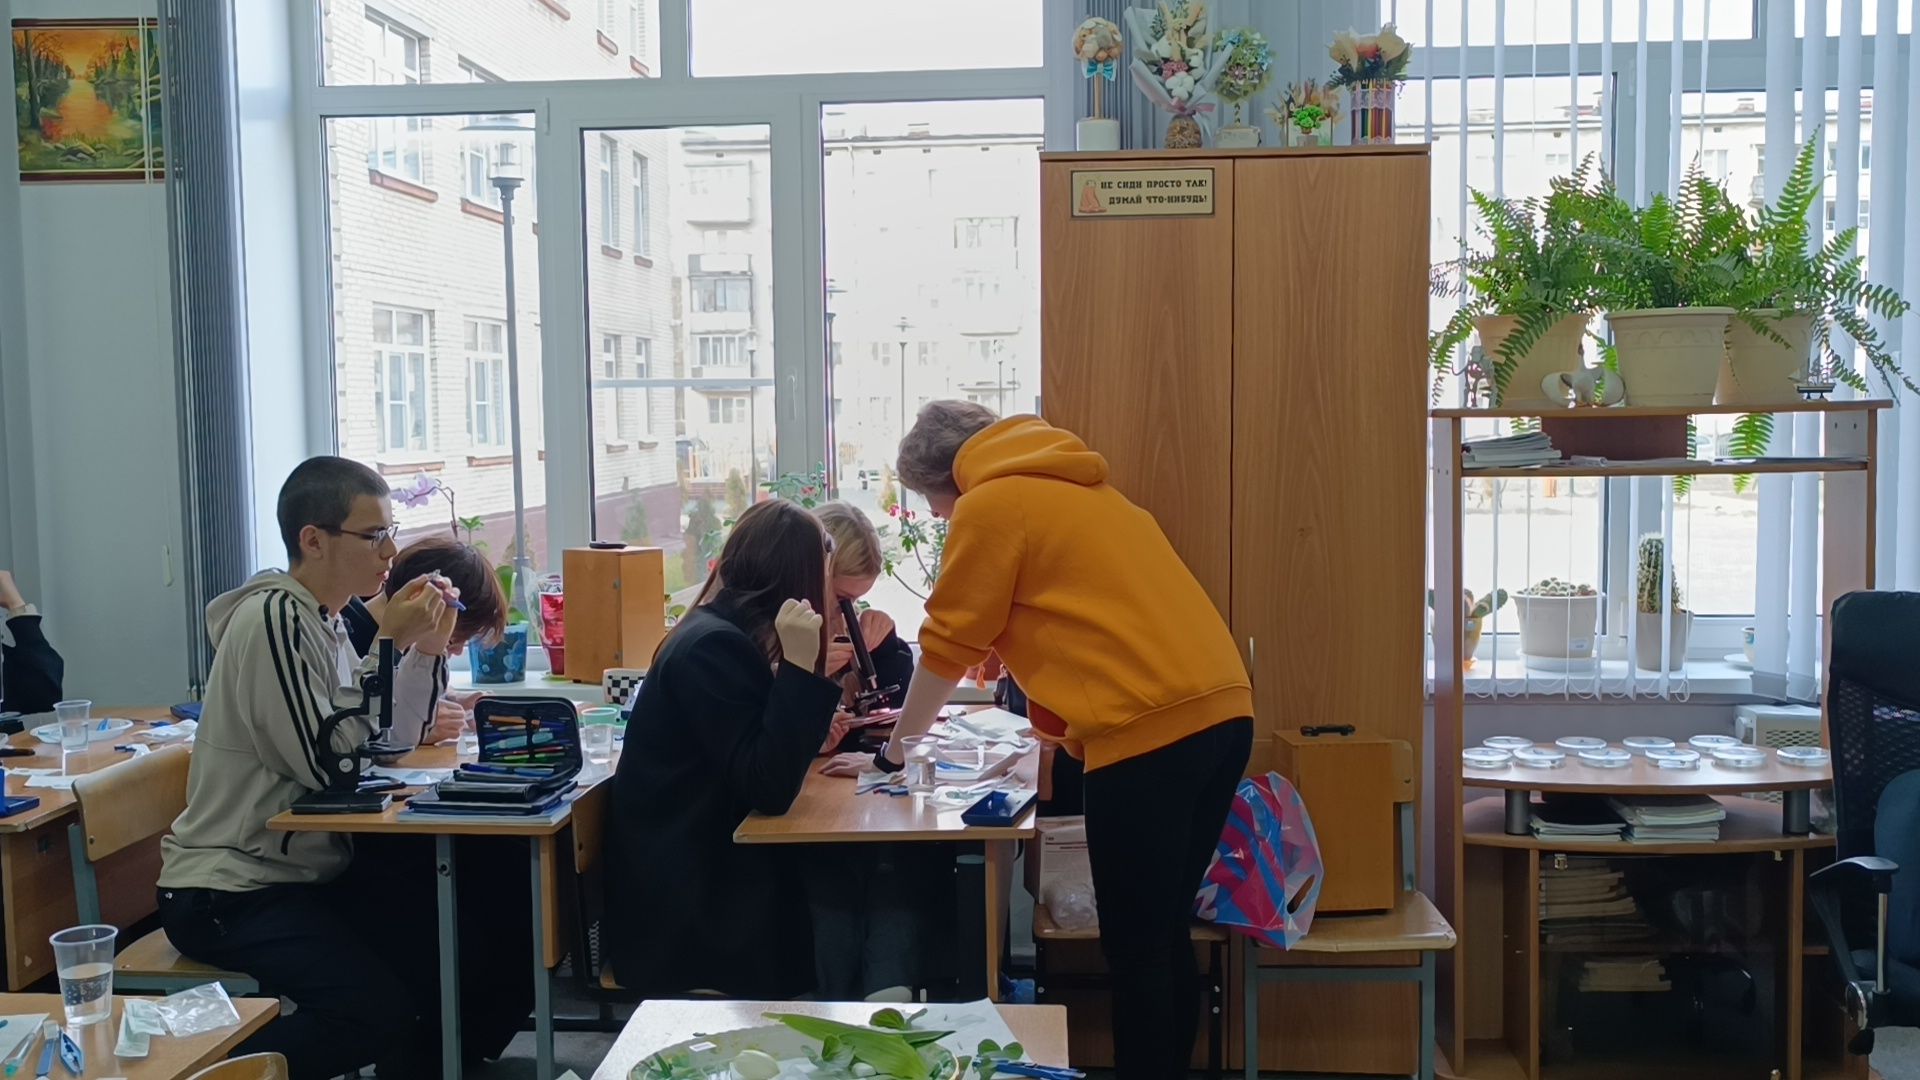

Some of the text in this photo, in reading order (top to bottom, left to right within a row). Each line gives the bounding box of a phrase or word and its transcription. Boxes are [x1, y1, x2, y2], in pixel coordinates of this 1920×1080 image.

[1146, 180, 1182, 188] ПРОСТО
[1185, 179, 1207, 188] ТАК!
[1108, 194, 1207, 205] ДУМАЙ ЧТО-НИБУДЬ!
